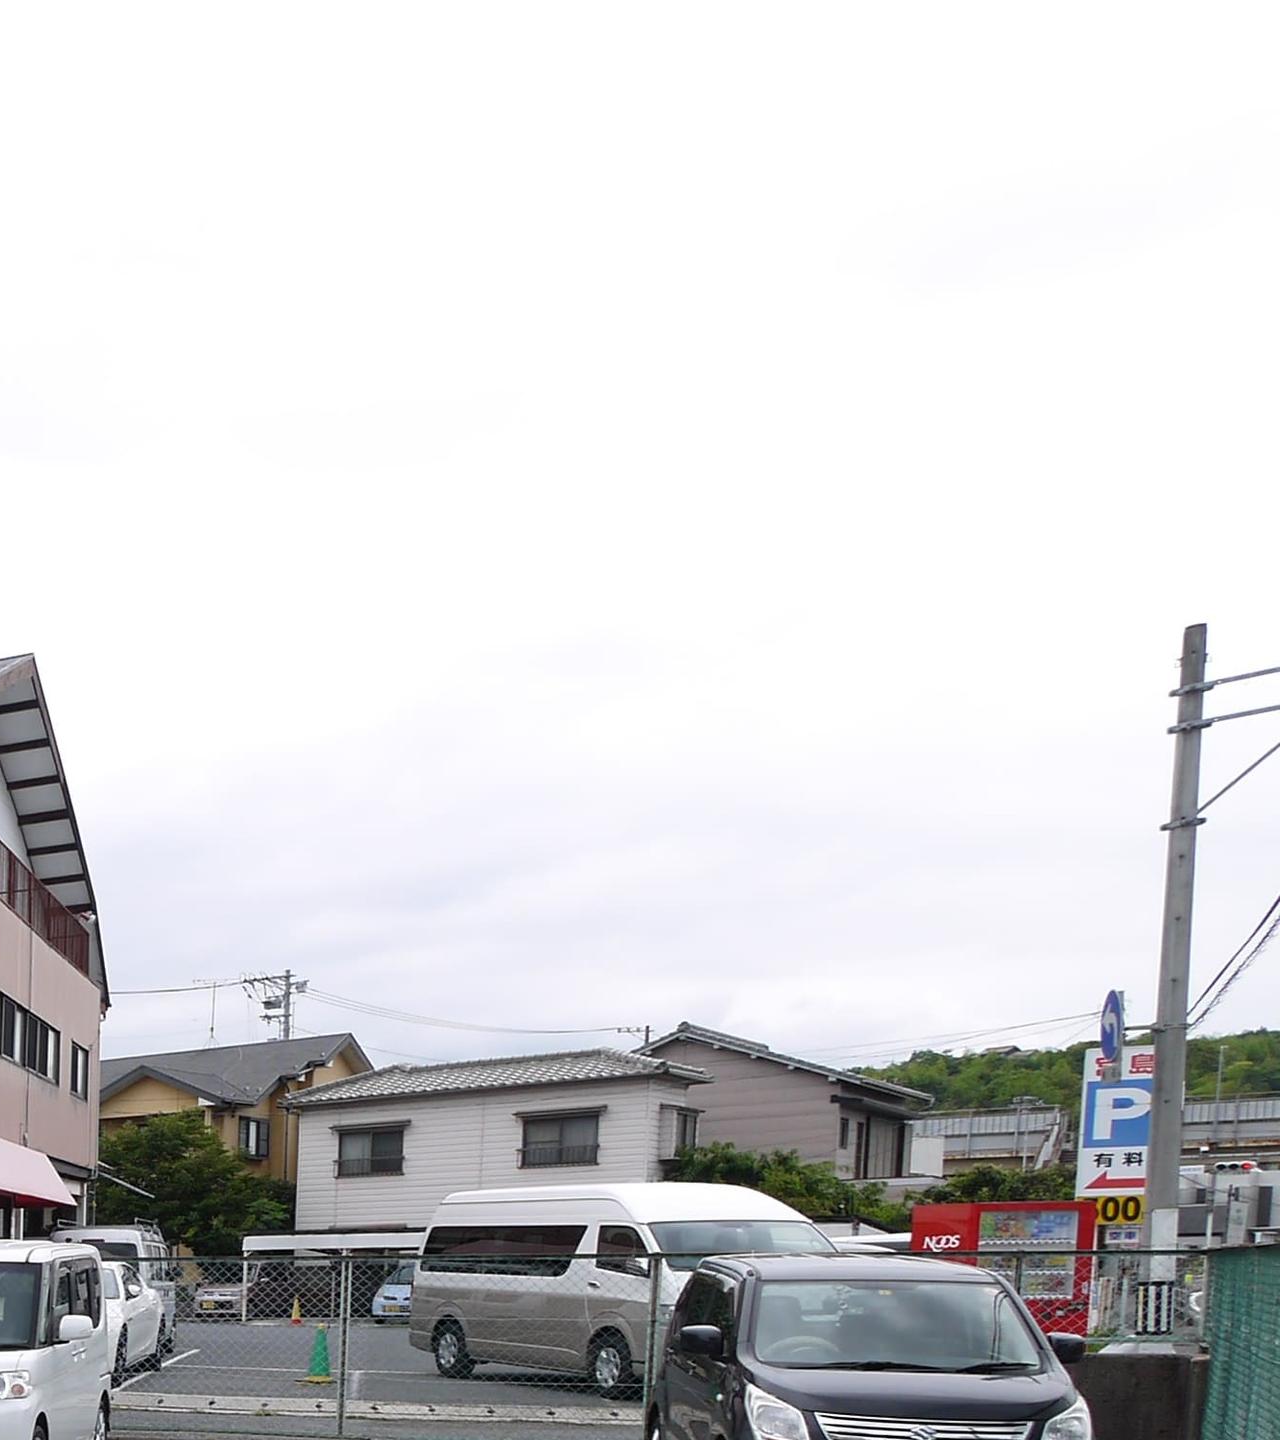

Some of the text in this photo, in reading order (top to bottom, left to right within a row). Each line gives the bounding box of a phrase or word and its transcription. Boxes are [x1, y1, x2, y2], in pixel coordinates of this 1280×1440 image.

[1093, 1087, 1151, 1140] P
[1093, 1152, 1144, 1168] 有料
[1095, 1195, 1141, 1223] 00
